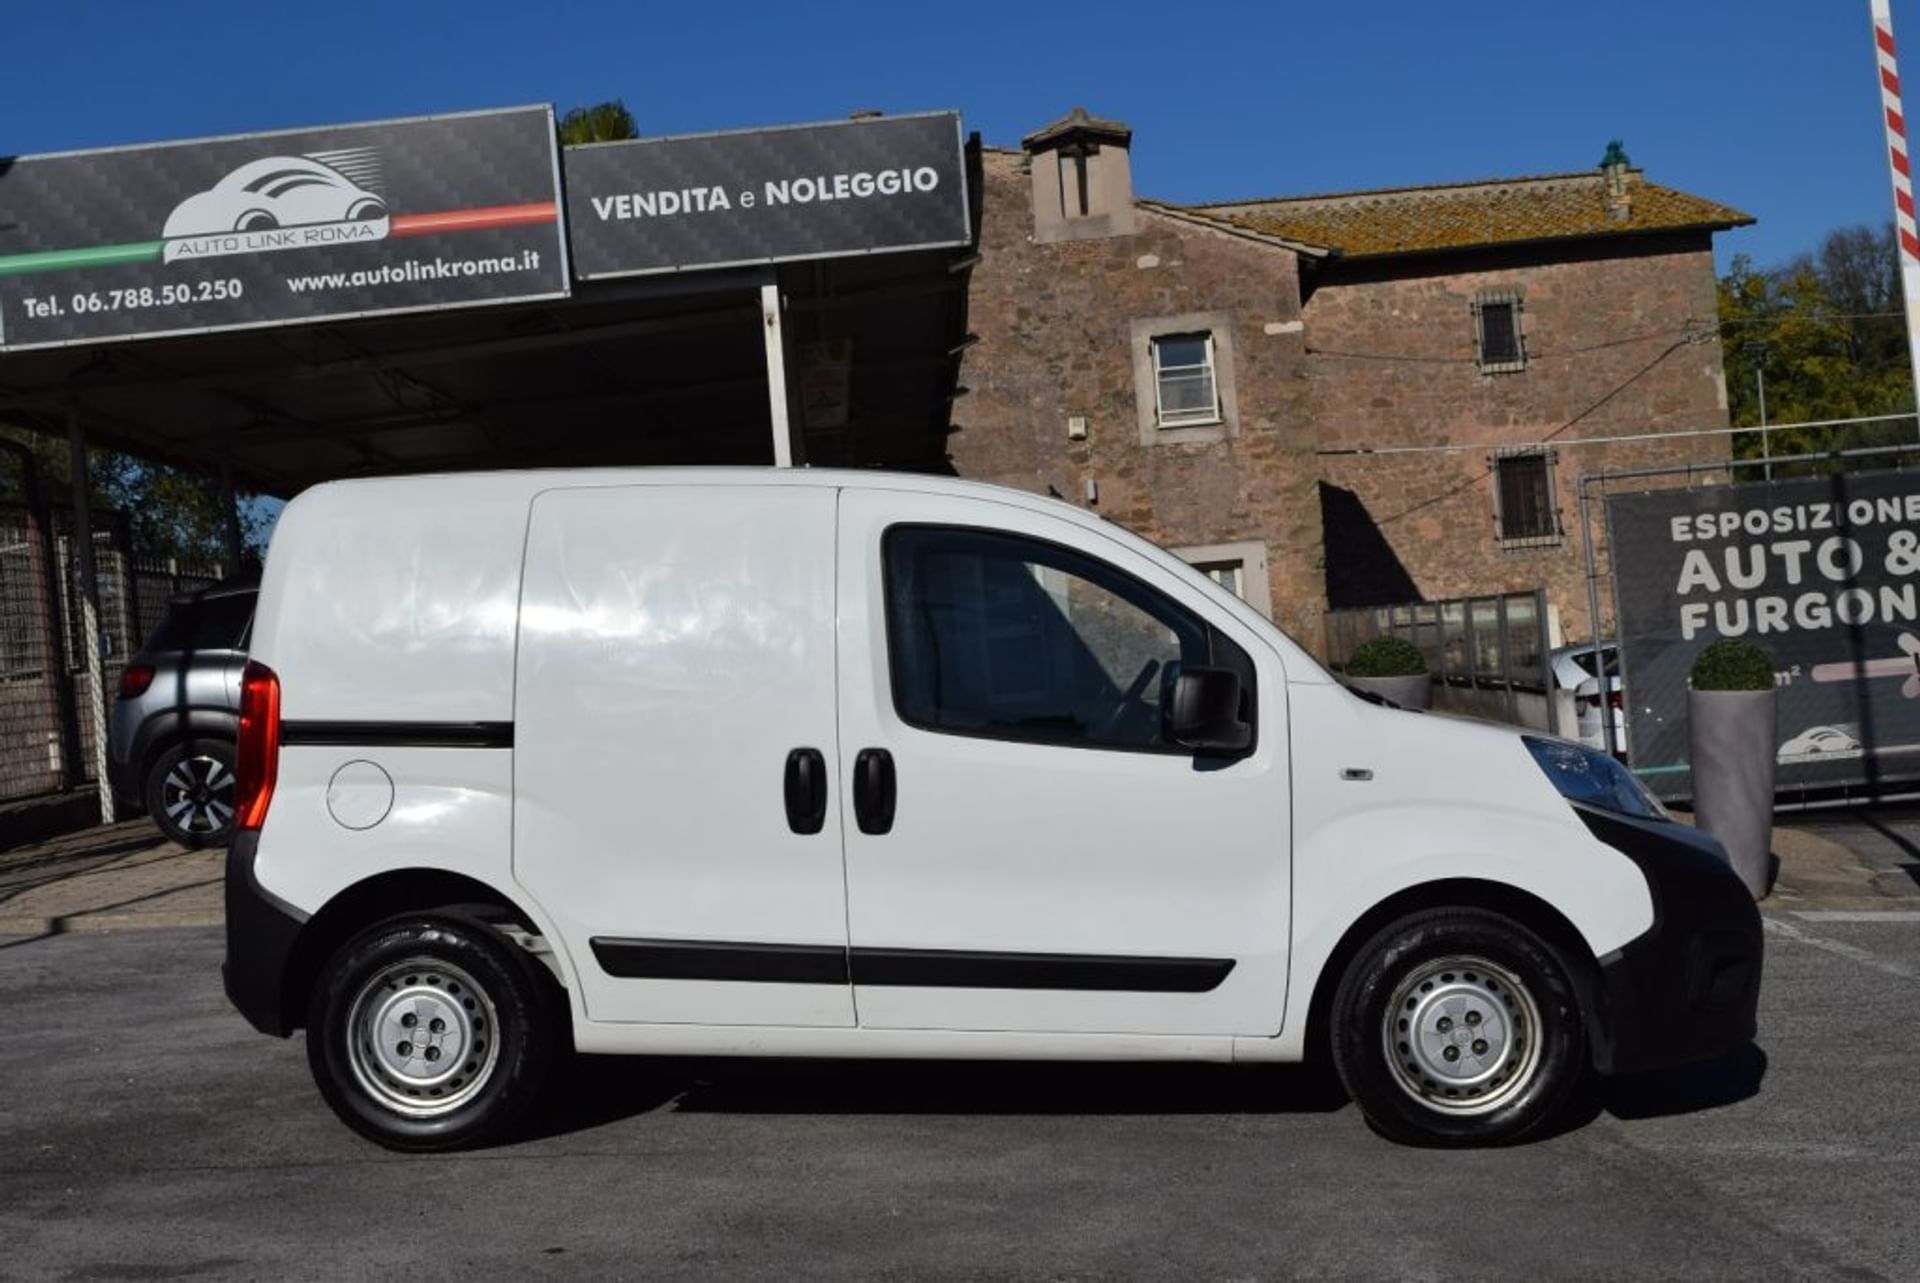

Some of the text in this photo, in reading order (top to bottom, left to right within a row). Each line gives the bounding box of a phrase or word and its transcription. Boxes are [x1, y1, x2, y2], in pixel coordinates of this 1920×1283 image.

[592, 167, 939, 220] VENDITA e NOLEGGIO
[176, 225, 375, 257] AUTO LINK ROMA
[288, 250, 540, 293] www.autolinkroma.it
[24, 279, 243, 318] Tel. 06.788.50.250
[1676, 536, 1863, 595] AUTO
